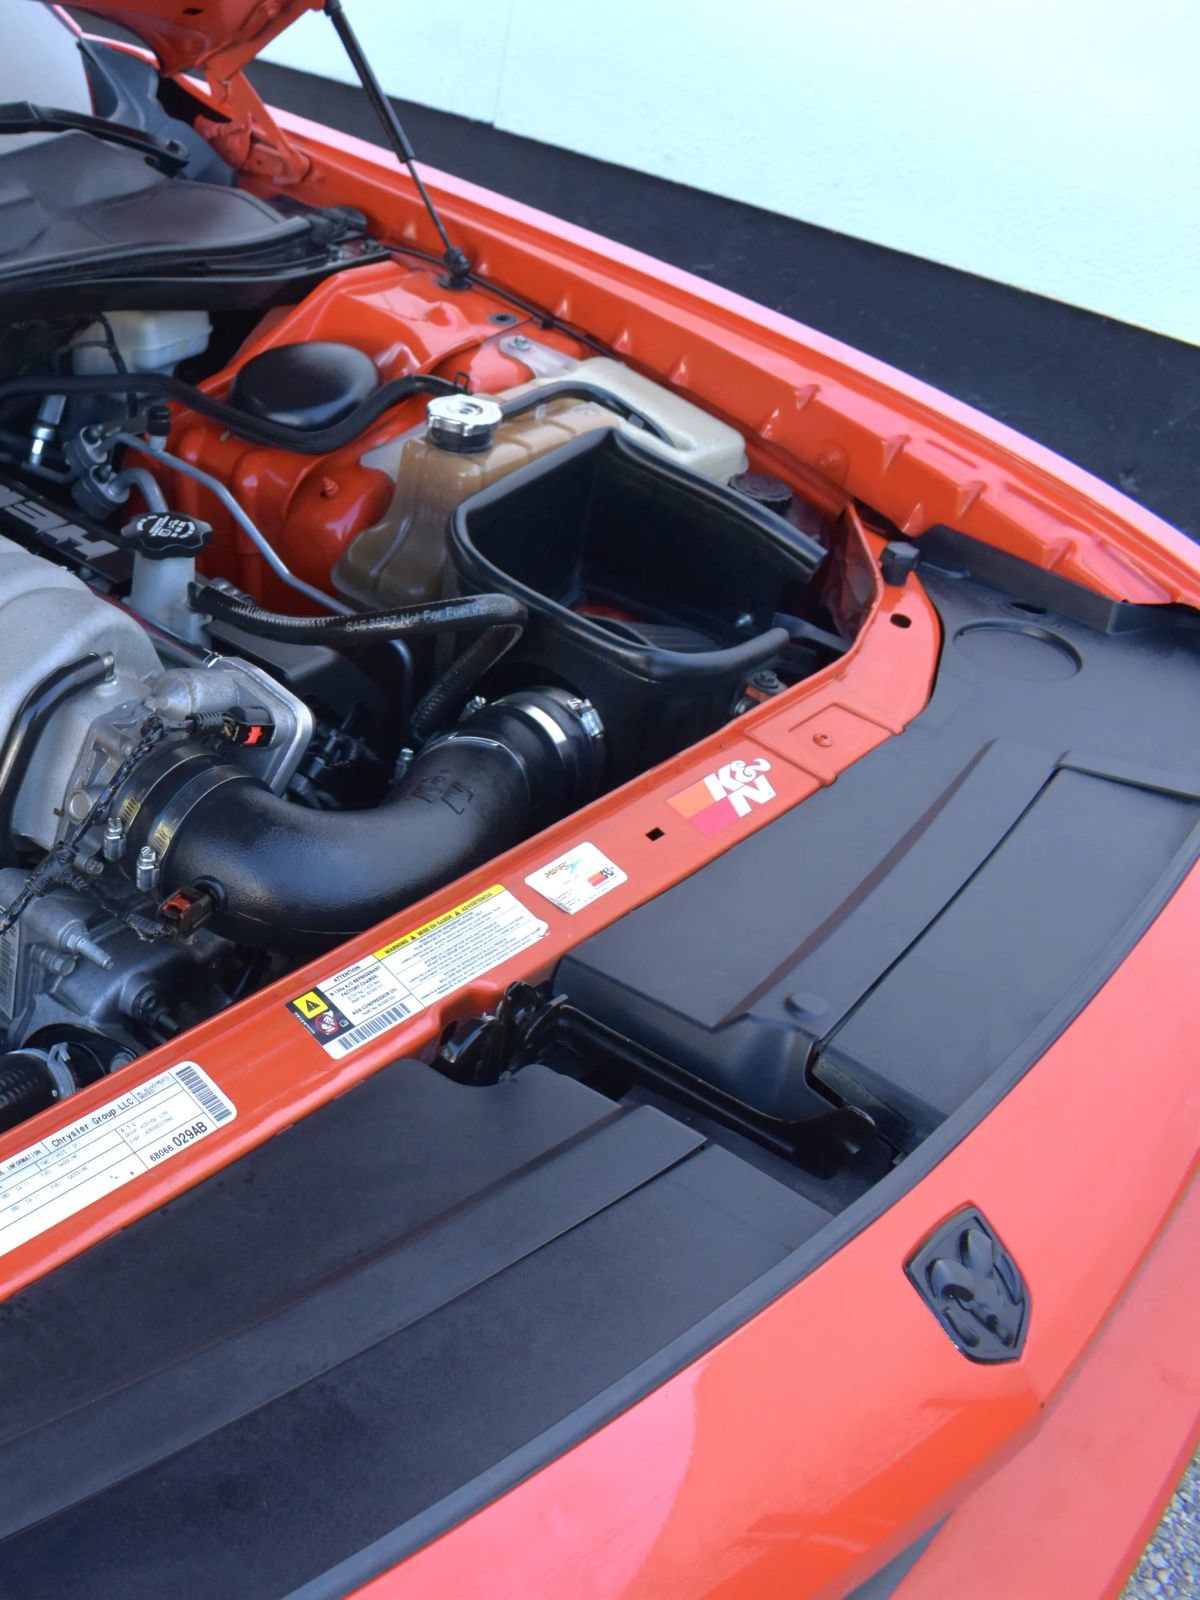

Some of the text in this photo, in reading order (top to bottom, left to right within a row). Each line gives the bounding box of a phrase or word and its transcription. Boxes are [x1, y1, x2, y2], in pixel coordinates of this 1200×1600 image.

[422, 608, 443, 624] For
[446, 603, 470, 618] Fuel
[703, 757, 777, 818] K&N
[384, 939, 408, 954] WARNING
[334, 966, 360, 982] ATTENTION
[51, 1124, 88, 1147] Chrysler
[92, 1109, 116, 1124] Group
[150, 1145, 174, 1161] 68066
[172, 1122, 207, 1146] 029AB
[7, 1150, 41, 1170] INFORMATION
